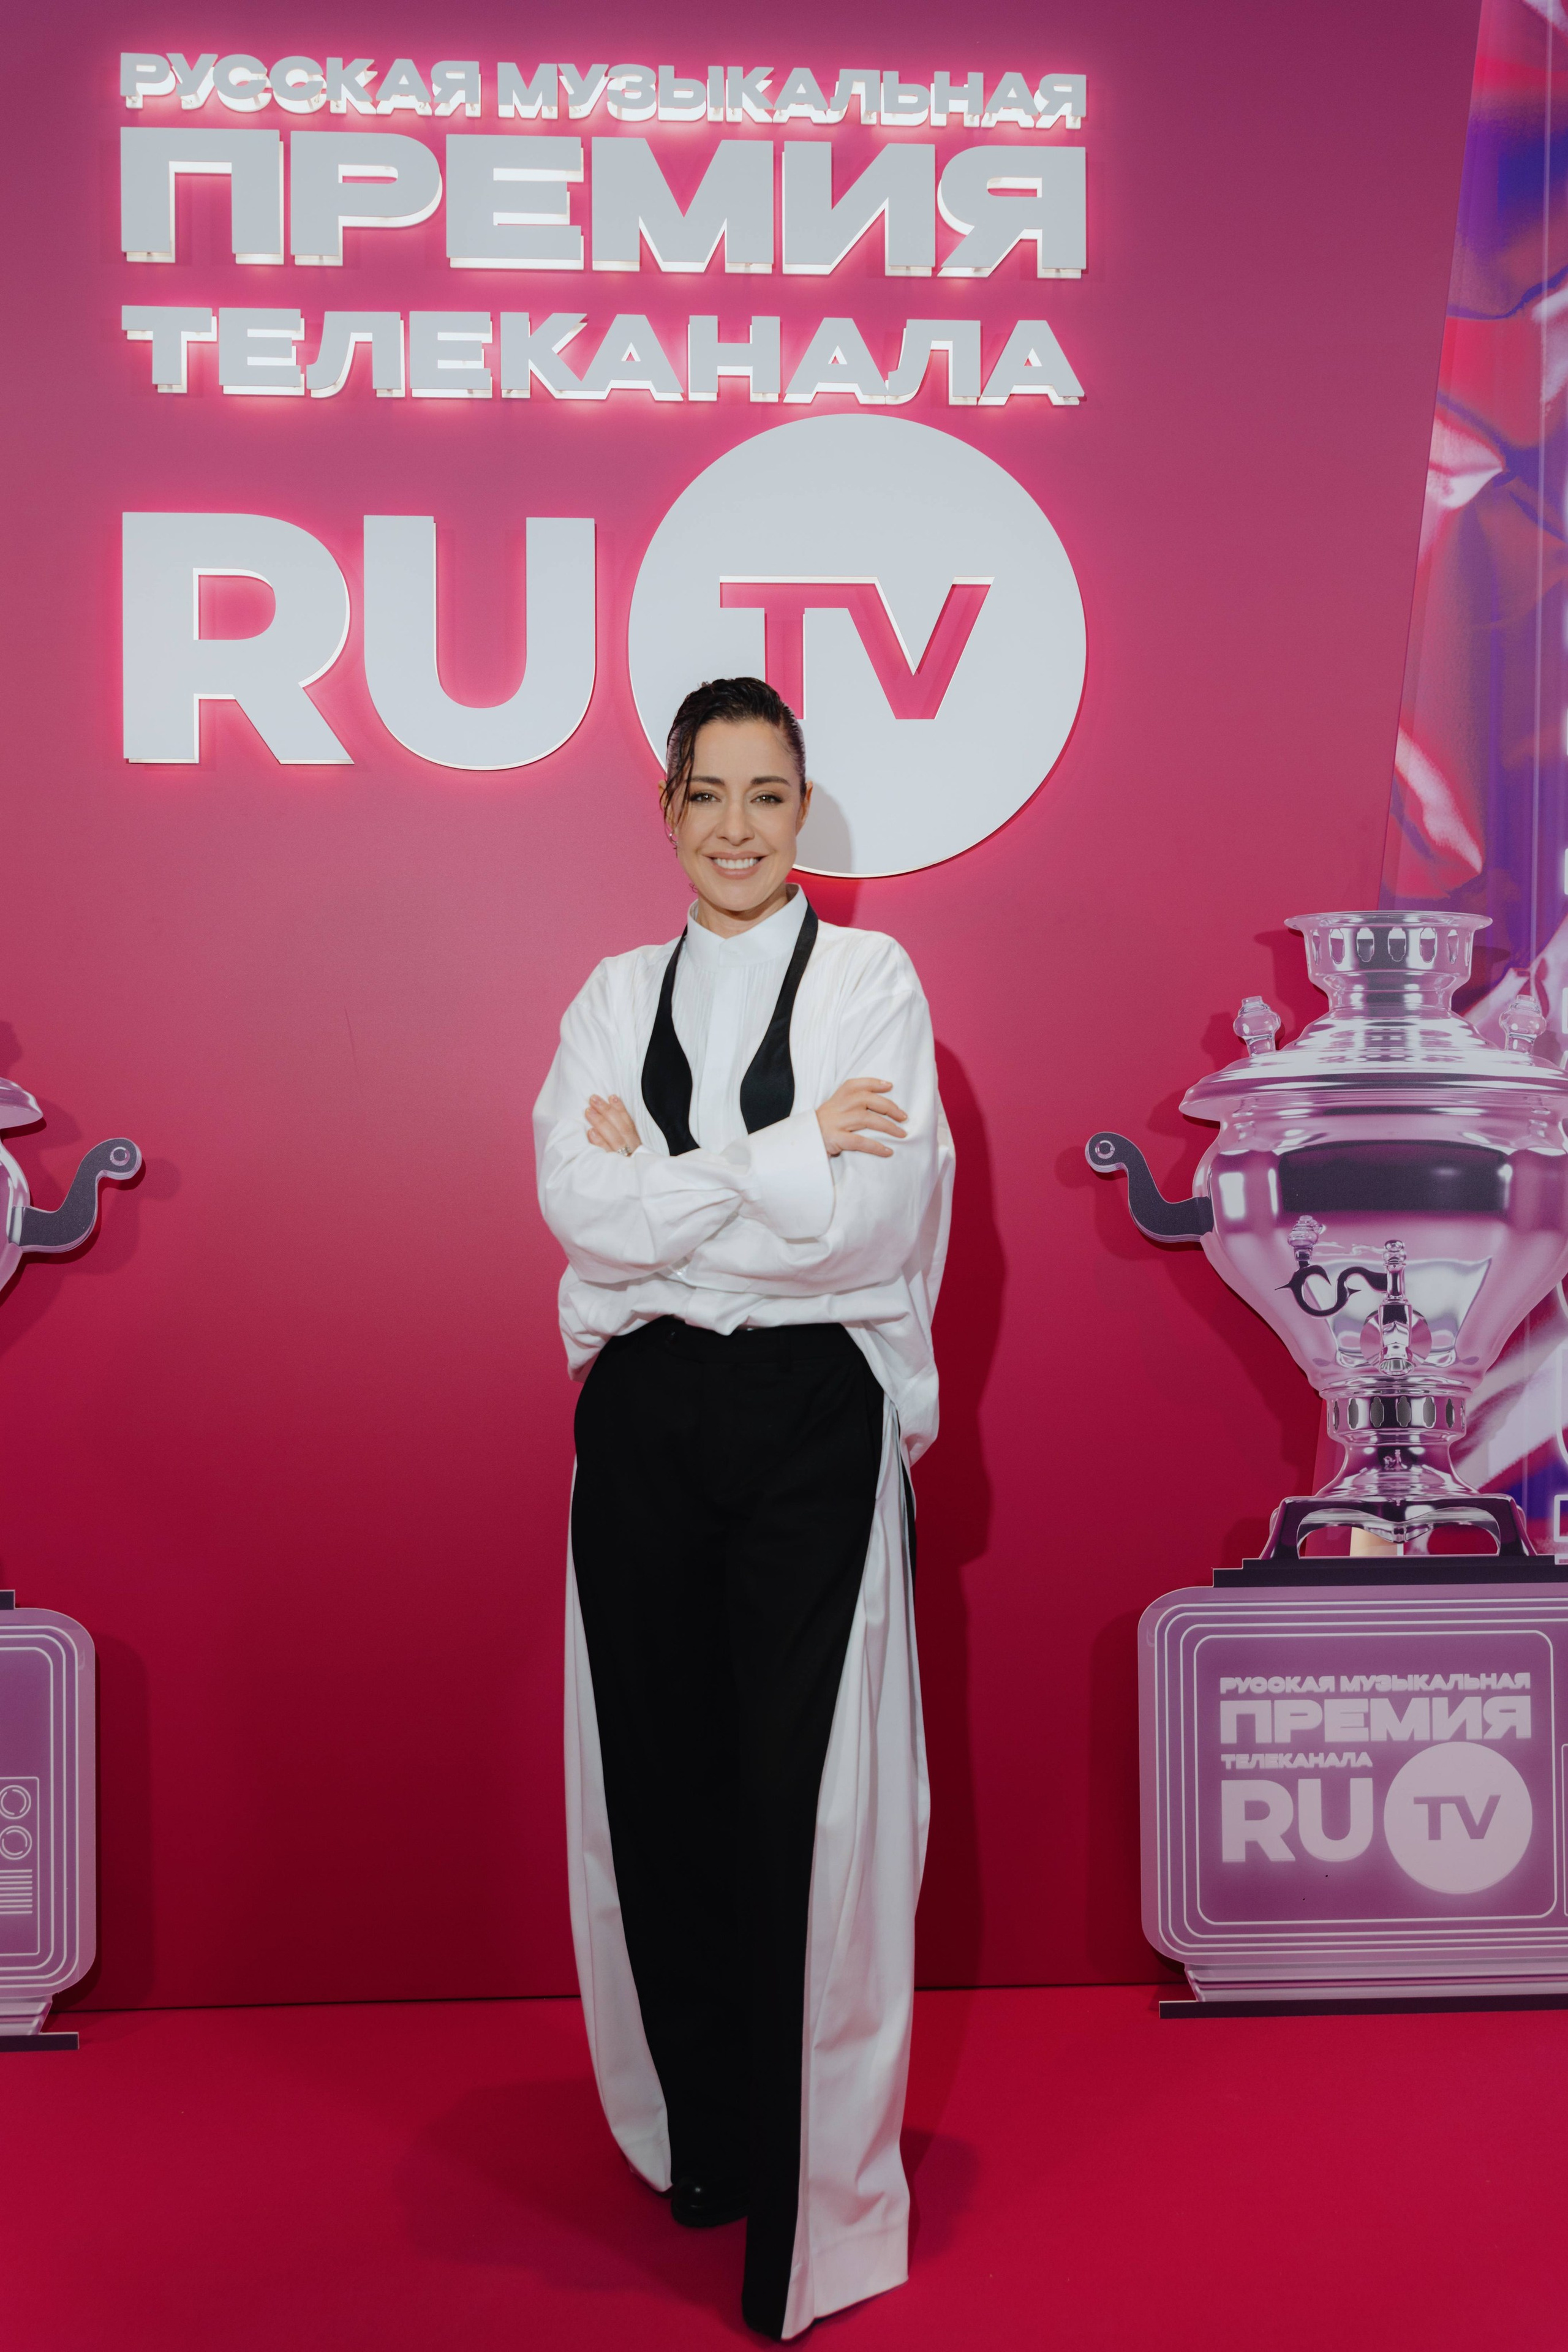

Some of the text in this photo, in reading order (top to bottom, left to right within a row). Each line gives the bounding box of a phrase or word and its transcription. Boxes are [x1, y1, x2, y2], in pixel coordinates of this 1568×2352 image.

[121, 53, 1087, 129] РУССКАЯ МУЗЫКАЛЬНАЯ
[121, 127, 1087, 279] ПРЕМИЯ
[122, 305, 1086, 405] ТЕЛЕКАНАЛА
[121, 511, 995, 771] RU TV
[1219, 1695, 1532, 1744] ПРЕМИЯ
[1340, 1672, 1531, 1692] МУЗЫКАЛЬНАЯ
[1221, 1751, 1373, 1770] ТЕЛЕКАНАЛА
[1221, 1777, 1502, 1863] RU TV
